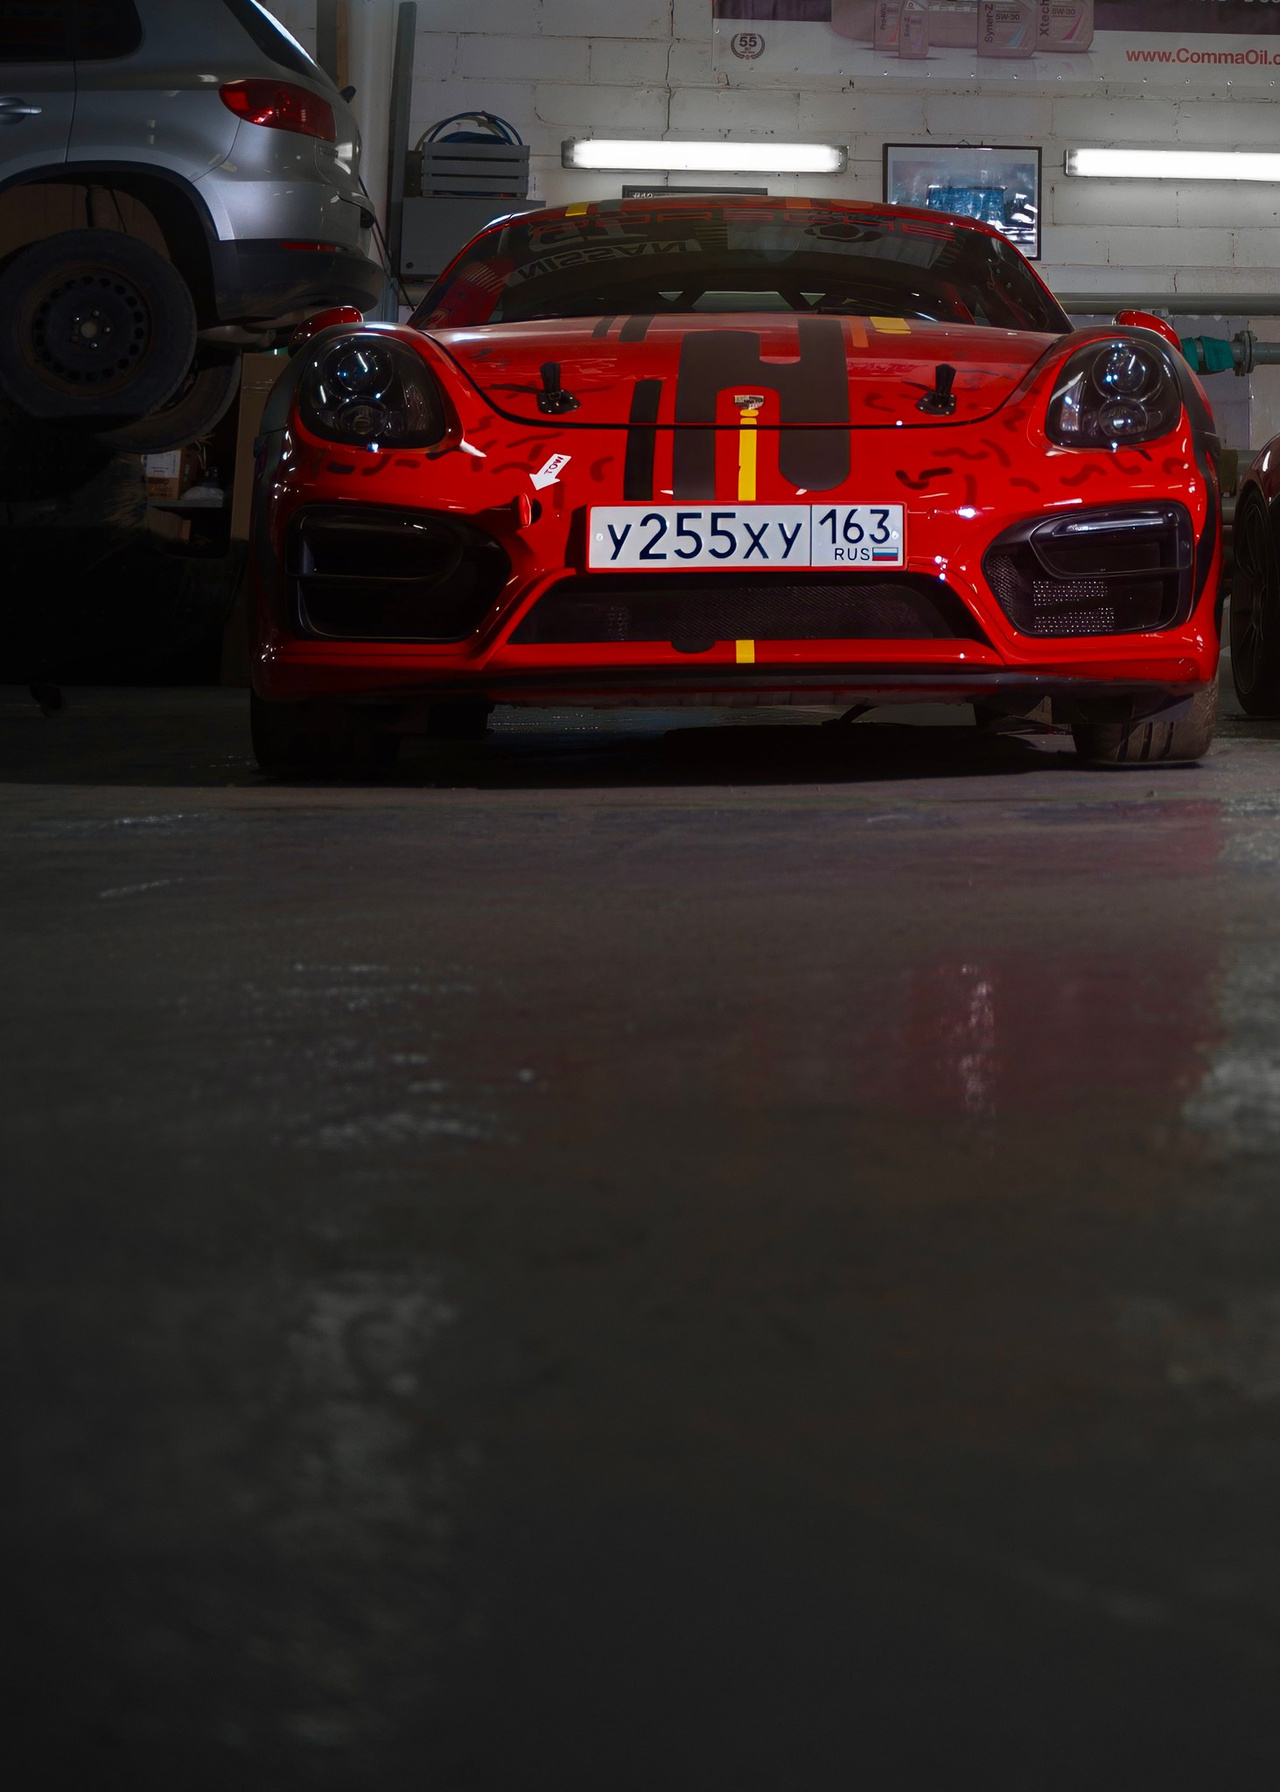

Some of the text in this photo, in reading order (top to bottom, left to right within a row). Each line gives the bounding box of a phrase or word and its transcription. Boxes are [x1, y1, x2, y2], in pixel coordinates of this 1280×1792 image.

[984, 4, 995, 43] Syner-Z
[995, 13, 1020, 21] 5W-30
[739, 36, 757, 48] 55
[544, 455, 564, 475] TOW
[818, 508, 891, 545] 163
[834, 547, 871, 561] RUS
